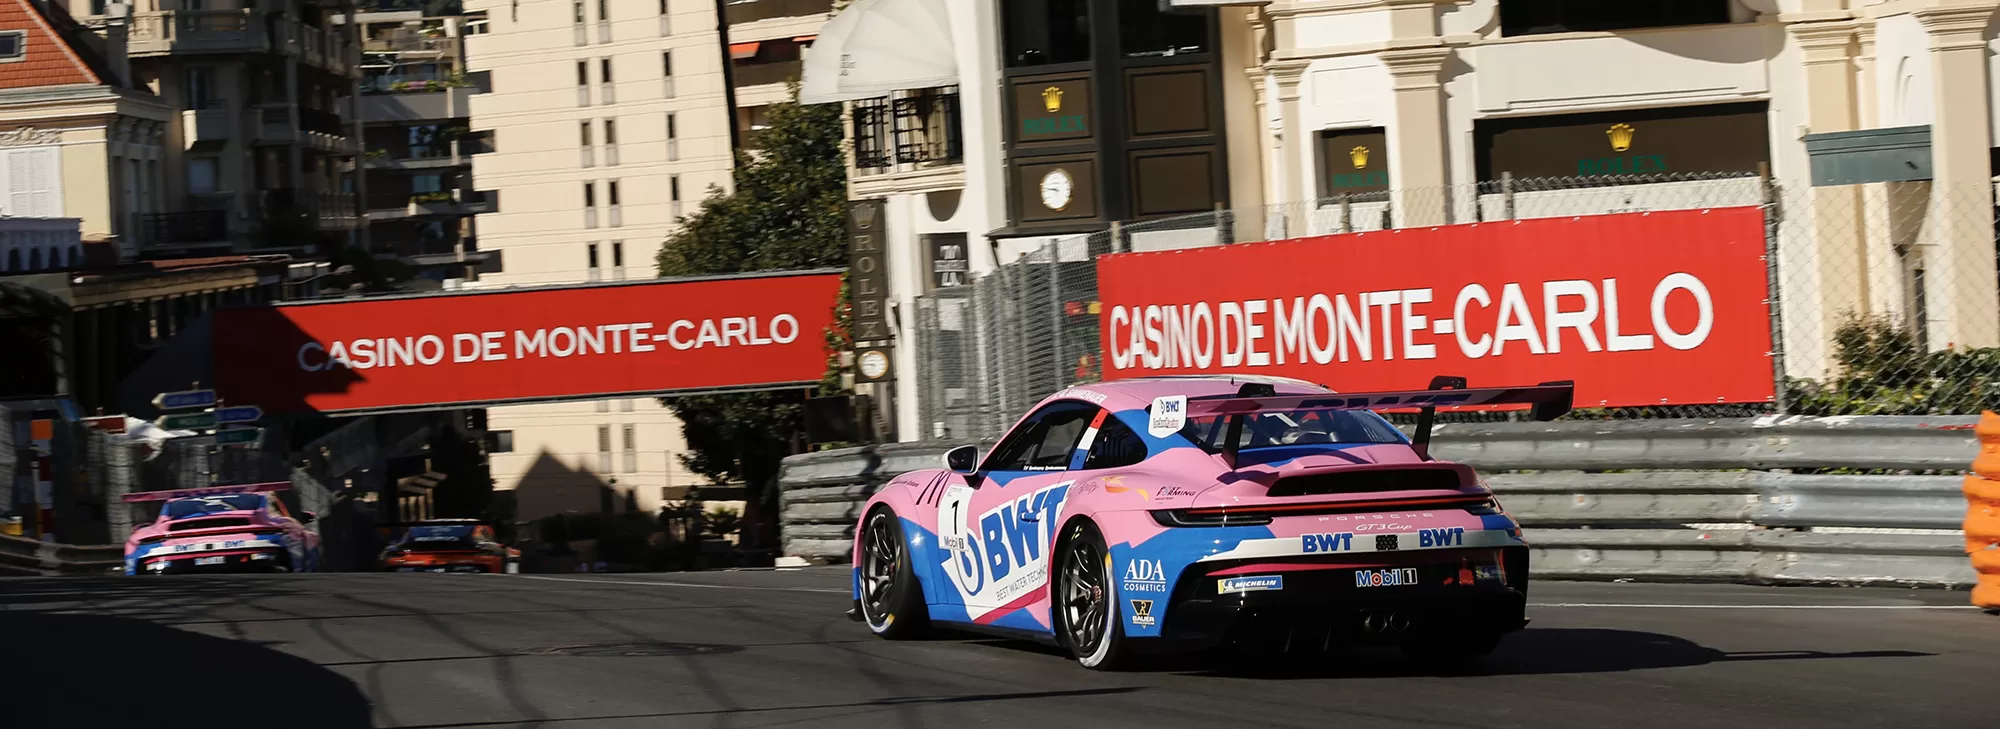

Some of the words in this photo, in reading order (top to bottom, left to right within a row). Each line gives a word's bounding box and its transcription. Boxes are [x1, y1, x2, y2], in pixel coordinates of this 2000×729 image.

[1023, 115, 1086, 135] ROLEX
[1576, 153, 1669, 176] ROLEX
[853, 233, 884, 340] ROLEX
[1109, 300, 1215, 371] CASINO
[1219, 300, 1271, 368] DE
[1272, 271, 1715, 366] MONTE-CARLO
[298, 334, 444, 373] CASINO
[453, 331, 508, 364] DE
[514, 312, 800, 360] MONTE-CARLO
[1165, 400, 1180, 412] BWT
[950, 500, 960, 535] 1
[1319, 512, 1434, 522] PORSCHE
[944, 536, 958, 548] Mobil
[981, 483, 1072, 583] BWT
[1302, 533, 1353, 553] BWT
[1418, 527, 1464, 548] BWT
[1124, 558, 1166, 580] ADA
[1356, 568, 1402, 587] Mobil
[996, 586, 1010, 601] BEST
[1009, 576, 1028, 592] WATER
[1124, 583, 1166, 592] COSMETICS
[1235, 580, 1277, 588] MICHELIN
